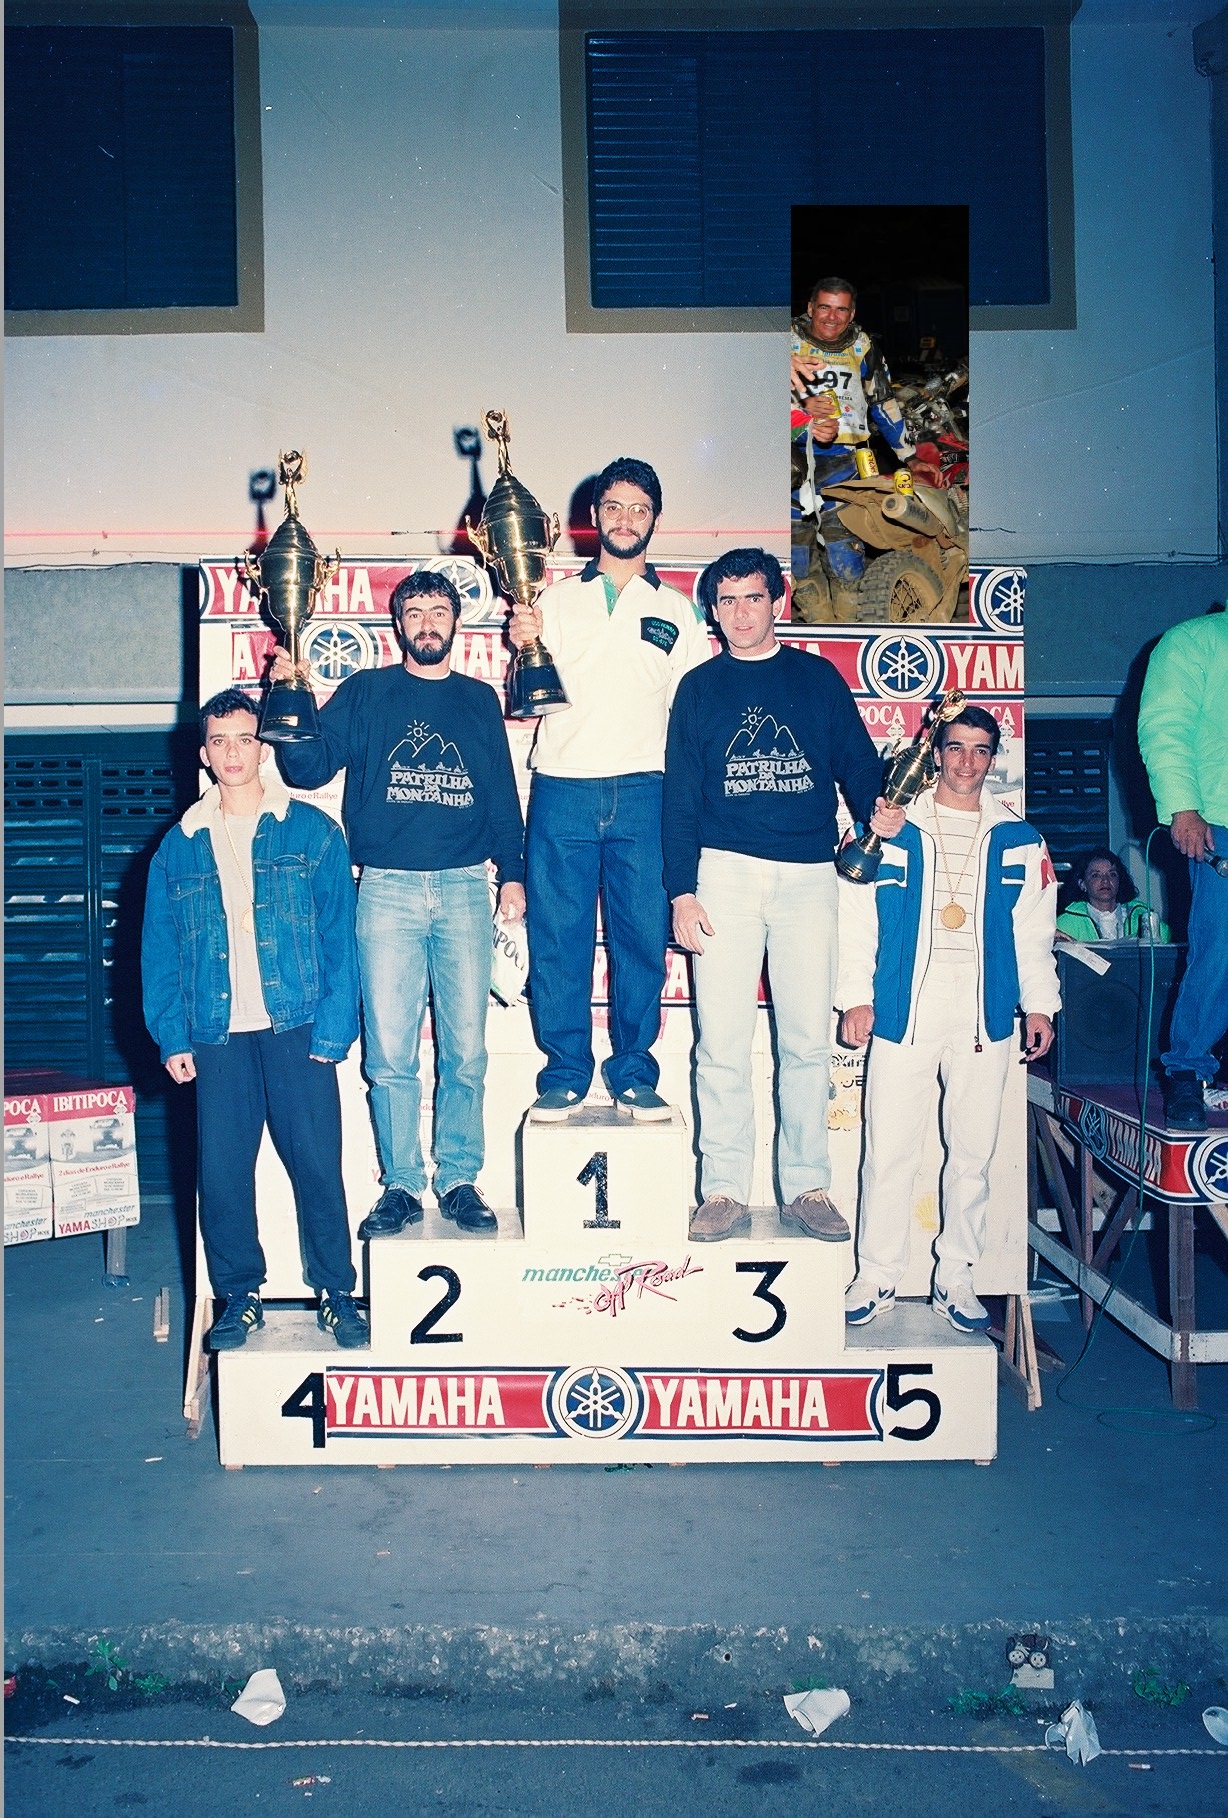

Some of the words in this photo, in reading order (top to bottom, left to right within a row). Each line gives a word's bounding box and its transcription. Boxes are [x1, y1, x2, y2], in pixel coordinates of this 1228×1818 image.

[725, 757, 812, 778] PATRILHA
[389, 771, 474, 790] PATRILHA
[723, 774, 814, 795] MONTANHA
[386, 786, 475, 807] MONTANHA
[53, 1090, 128, 1113] IBITIPOCA
[577, 1151, 621, 1229] 1
[4, 1216, 48, 1229] anchester
[84, 1204, 135, 1218] manchester
[410, 1264, 463, 1345] 2
[732, 1260, 789, 1343] 3
[281, 1372, 327, 1448] 4
[327, 1377, 506, 1426] YAMAHA
[652, 1378, 829, 1428] YAMAHA
[886, 1363, 942, 1441] 5
